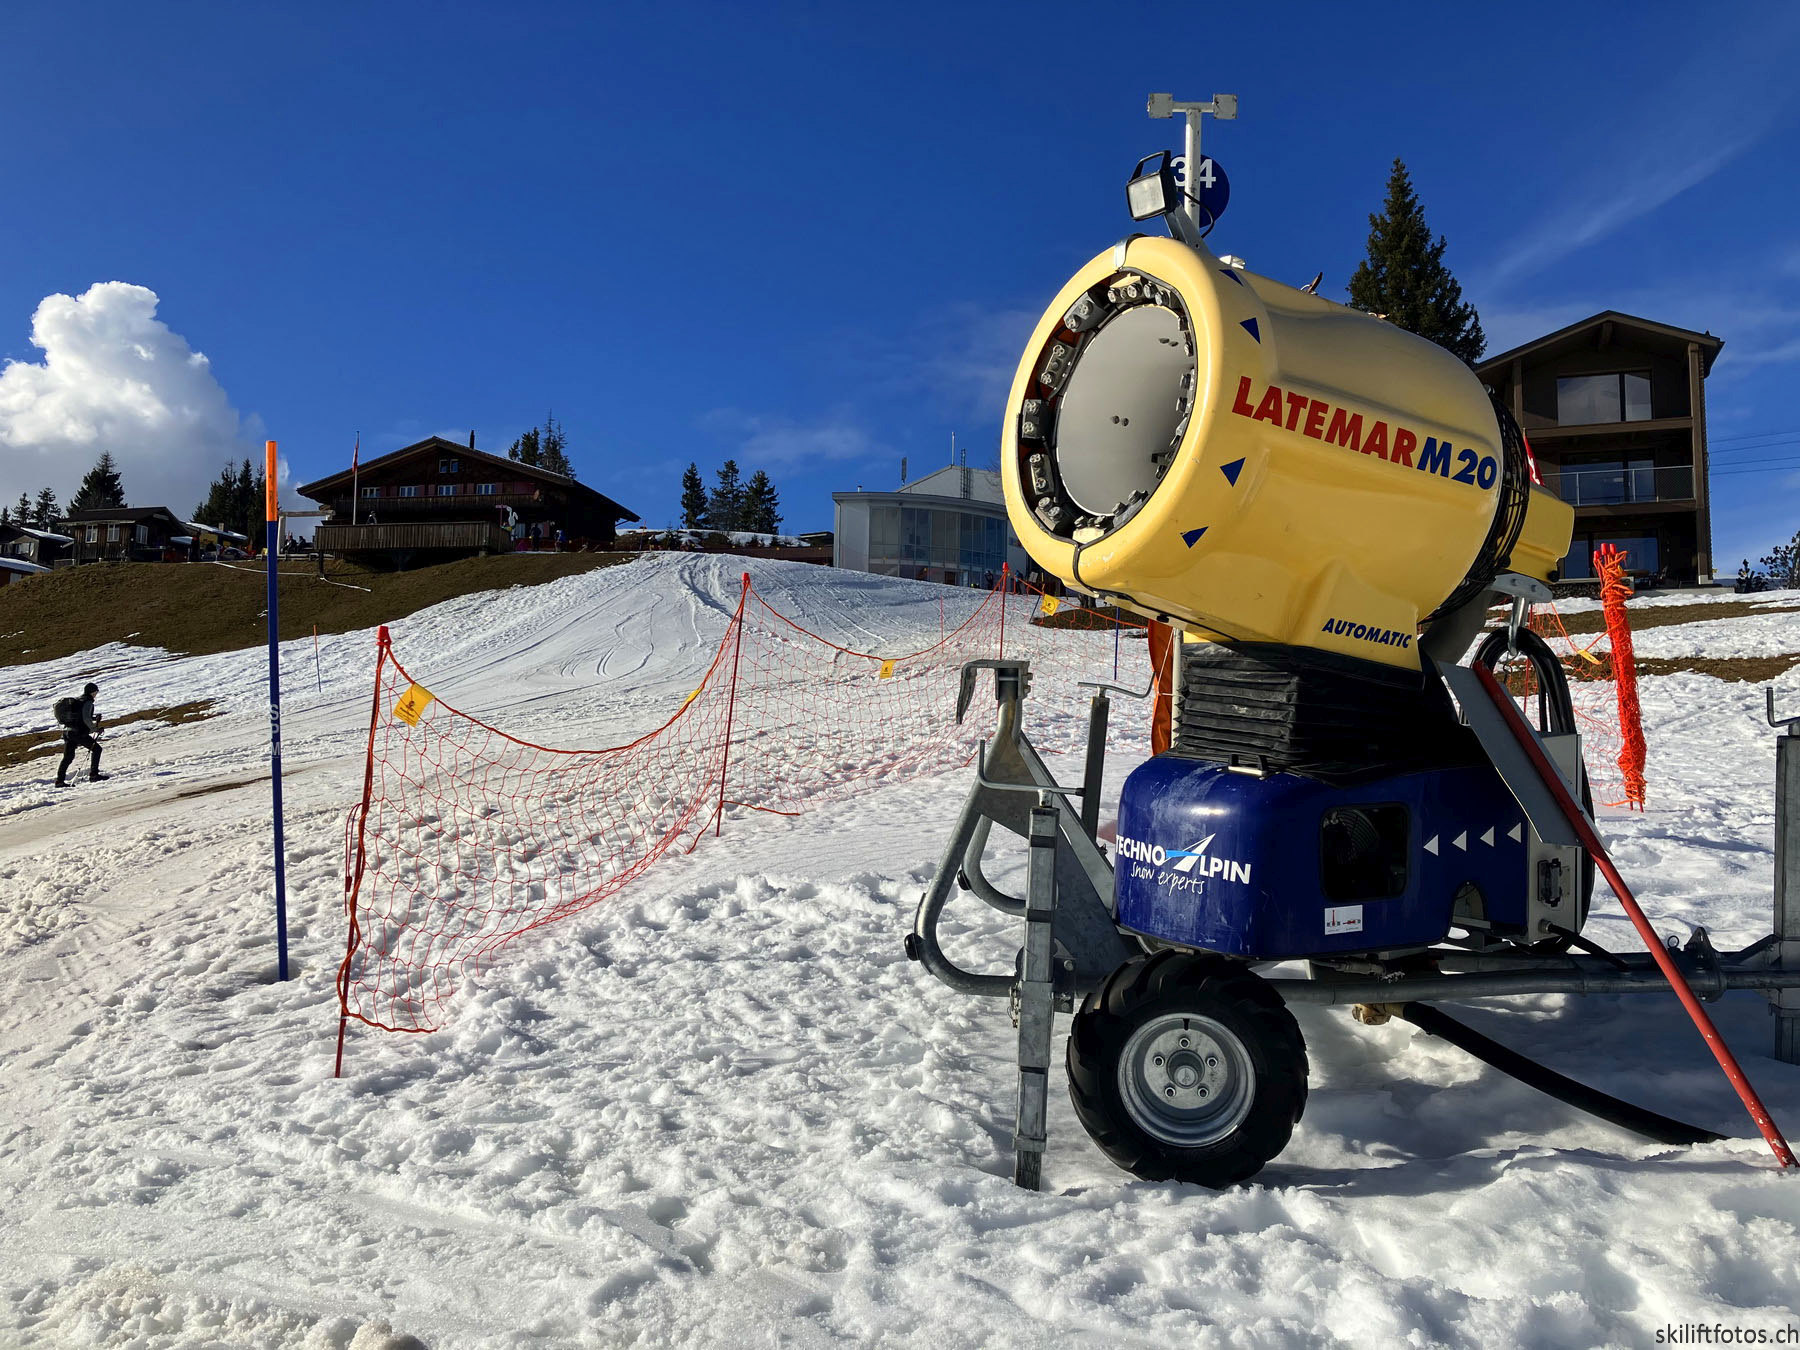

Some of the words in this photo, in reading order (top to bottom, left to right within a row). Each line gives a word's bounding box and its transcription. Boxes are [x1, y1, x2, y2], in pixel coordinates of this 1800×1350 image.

[1170, 157, 1216, 188] 34
[1232, 376, 1417, 468] LATEMAR
[1322, 618, 1412, 648] AUTOMATIC
[1158, 871, 1204, 896] experts
